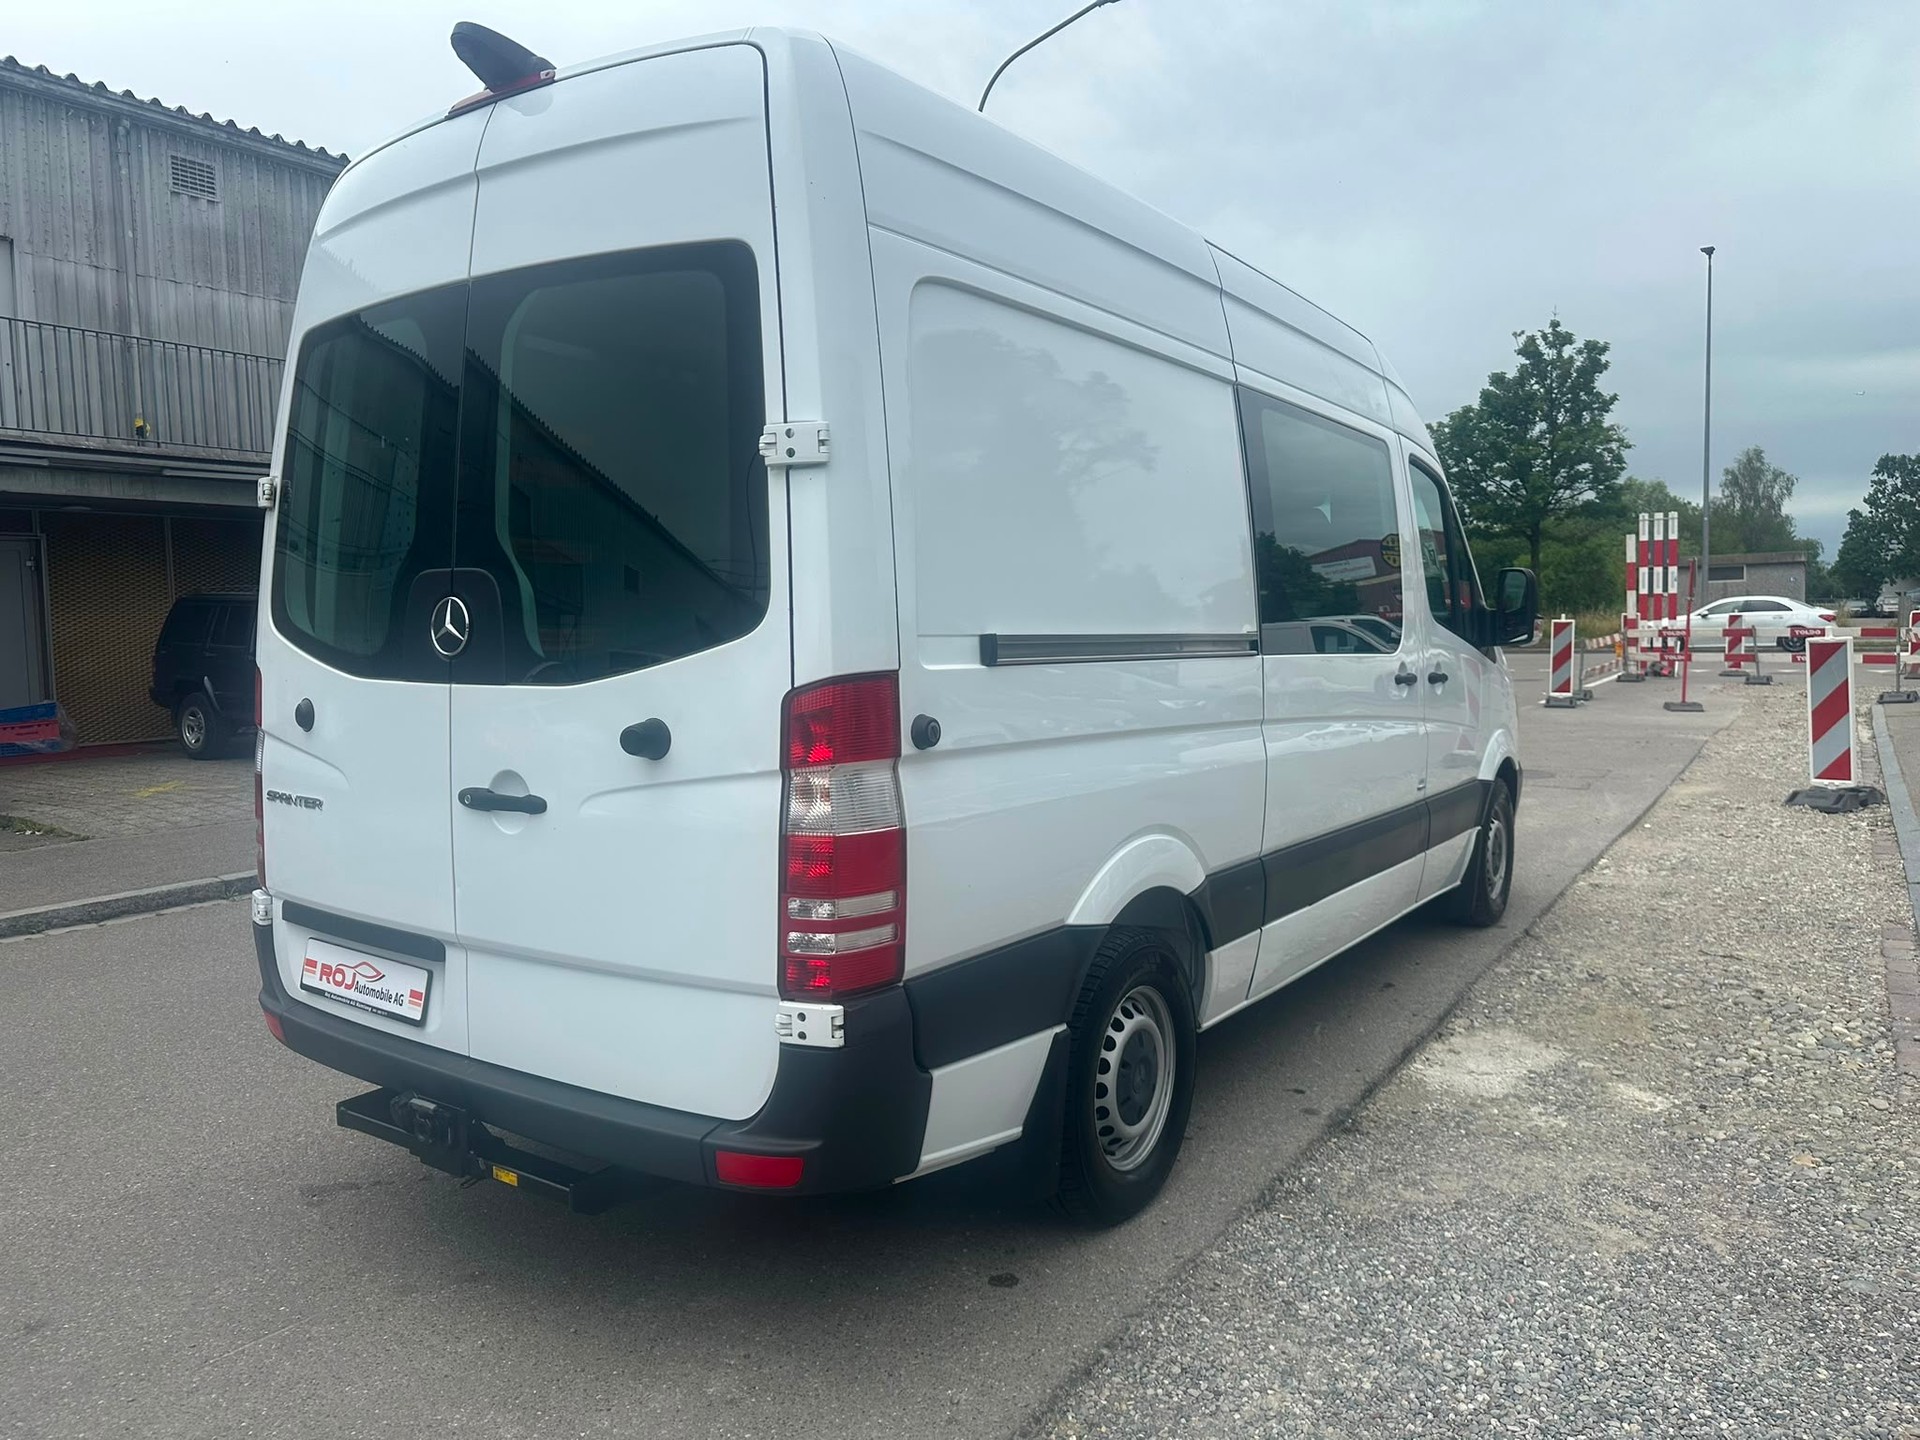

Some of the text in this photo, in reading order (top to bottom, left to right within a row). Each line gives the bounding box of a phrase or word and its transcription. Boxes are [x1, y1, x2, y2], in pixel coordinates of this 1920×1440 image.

[266, 790, 324, 811] SPRINTER
[319, 962, 357, 990] ROJ
[354, 980, 405, 1006] Automobile AG
